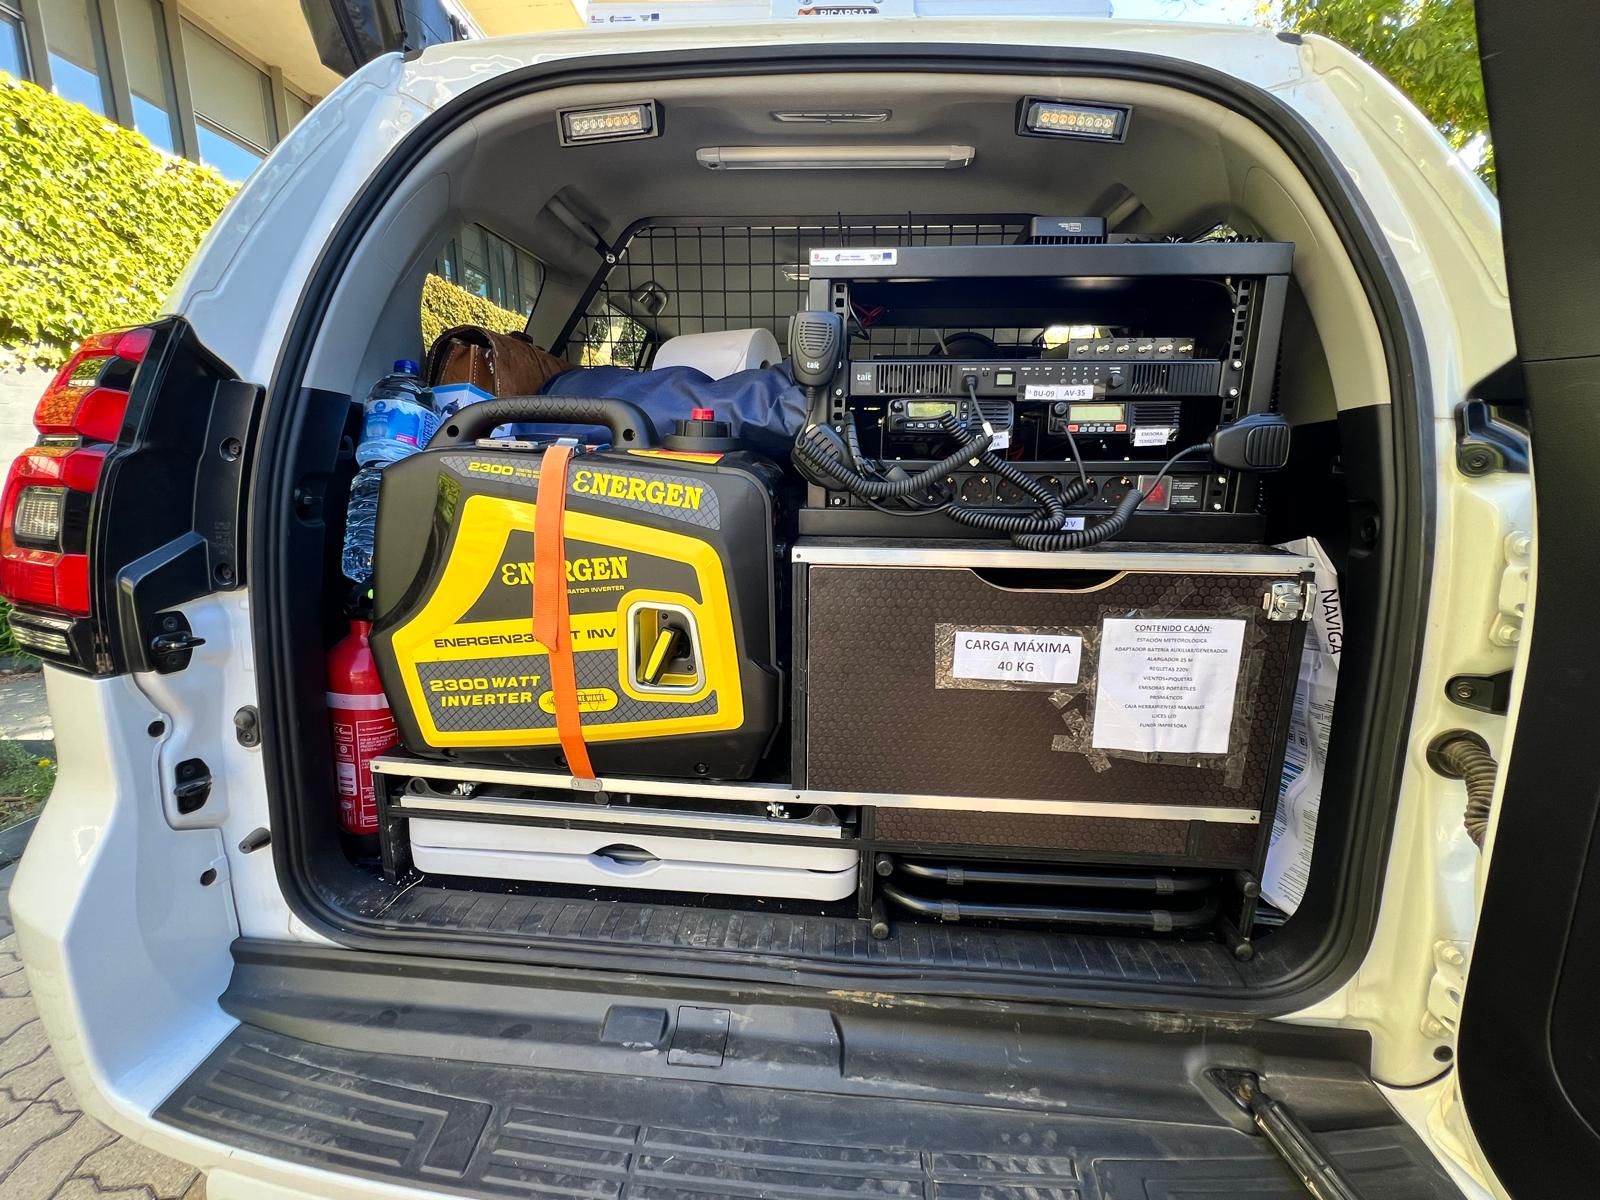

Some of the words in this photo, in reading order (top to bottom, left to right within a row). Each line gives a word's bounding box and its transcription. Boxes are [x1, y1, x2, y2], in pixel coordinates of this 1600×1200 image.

[857, 373, 872, 381] tait
[1063, 389, 1087, 397] AV-35
[467, 461, 515, 476] 2300
[572, 470, 704, 510] ENERGEN
[501, 556, 628, 586] ENRGEN
[590, 585, 625, 593] INVERTER
[1134, 624, 1182, 633] CONTENIDO
[1183, 624, 1213, 633] CAJÓN:
[434, 633, 535, 649] ENERGEN23
[964, 639, 1010, 652] CARGA
[1013, 639, 1071, 654] MÁXIMA
[997, 661, 1013, 672] 40
[1016, 662, 1035, 673] KG
[429, 677, 489, 693] 2300
[491, 675, 541, 689] WATT
[441, 691, 533, 708] INVERTER
